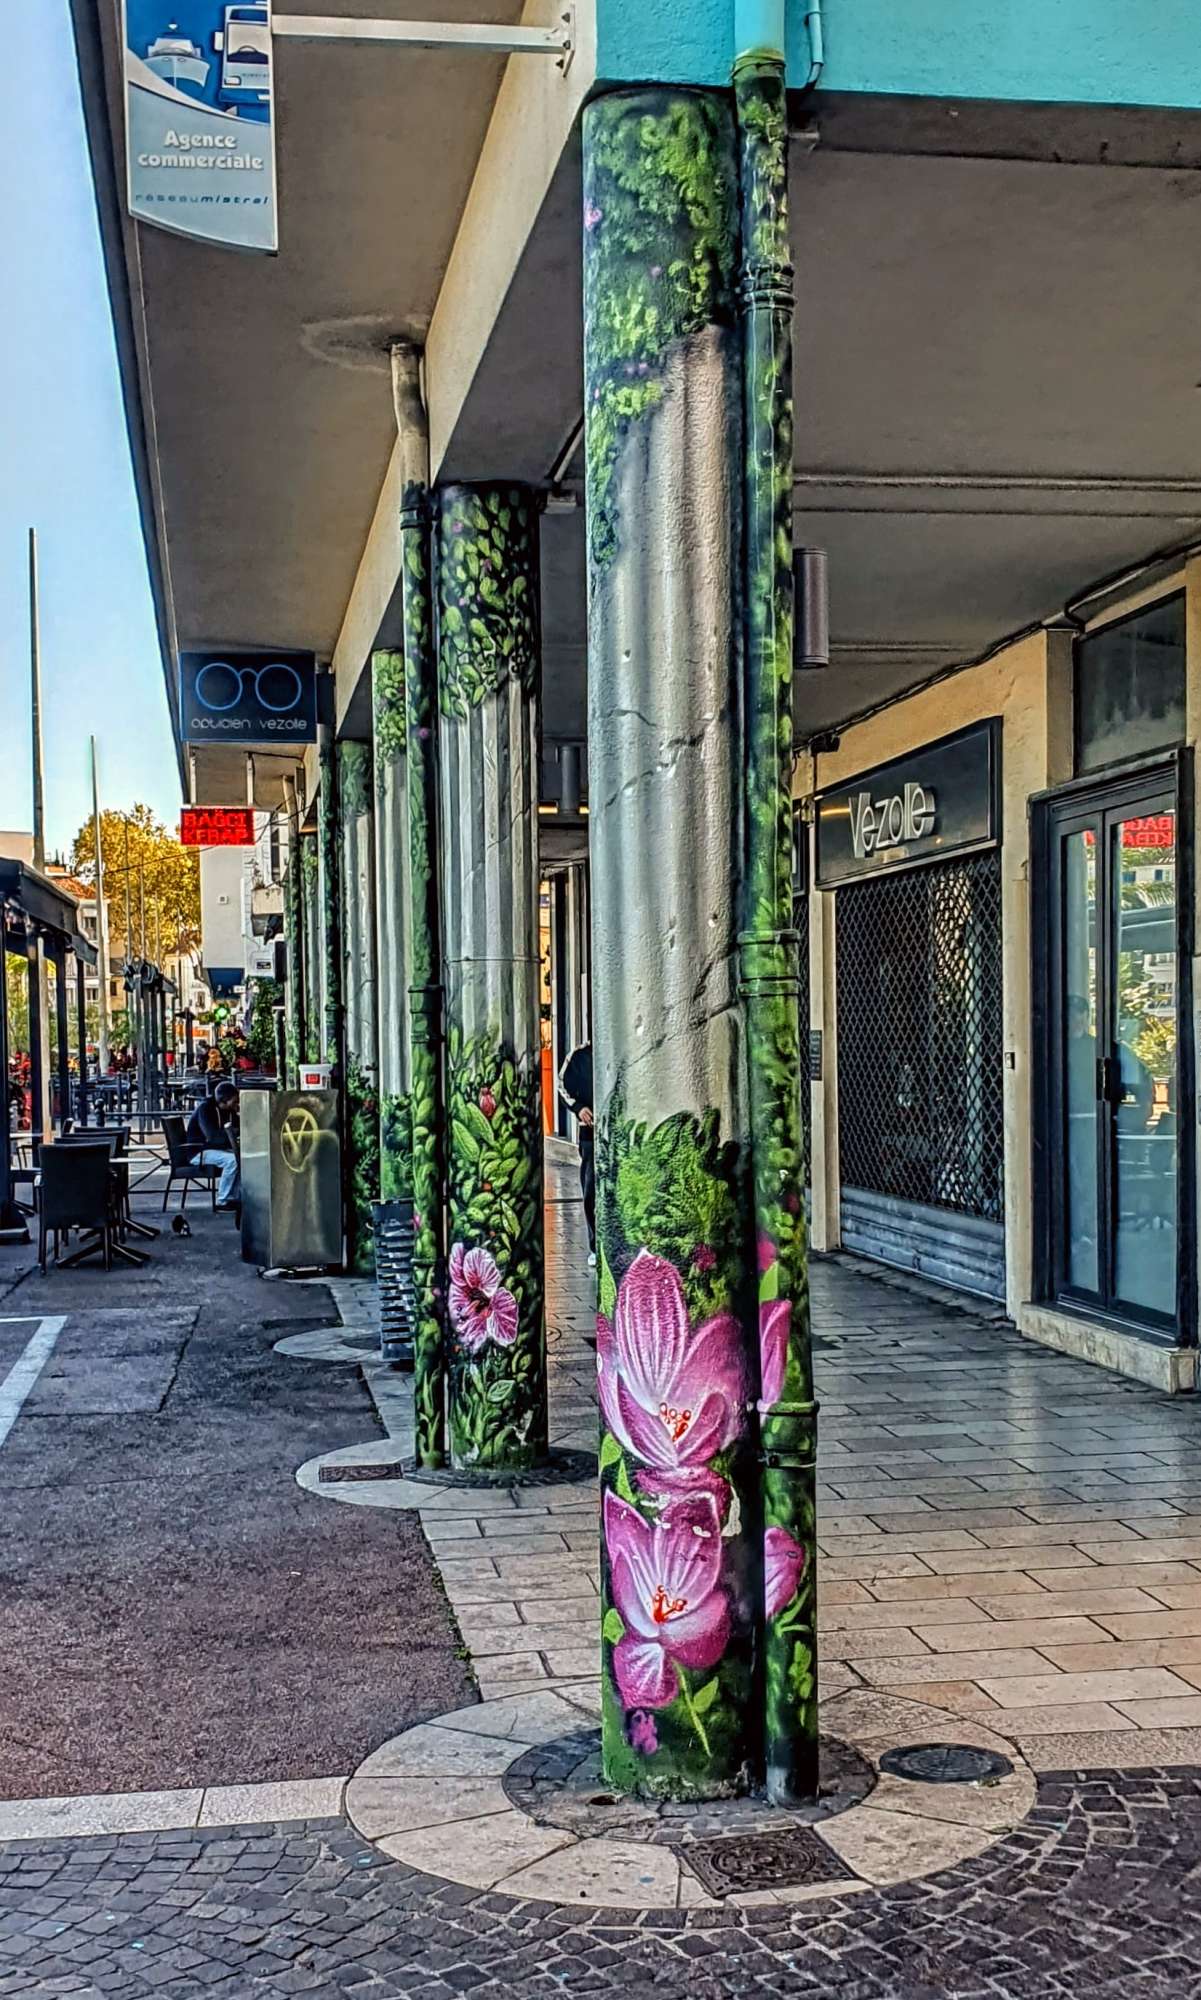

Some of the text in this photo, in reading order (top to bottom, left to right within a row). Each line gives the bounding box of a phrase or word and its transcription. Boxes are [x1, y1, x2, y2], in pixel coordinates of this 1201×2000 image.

[164, 130, 237, 151] Agence
[138, 152, 264, 170] commerciale
[848, 782, 936, 858] Vezolle
